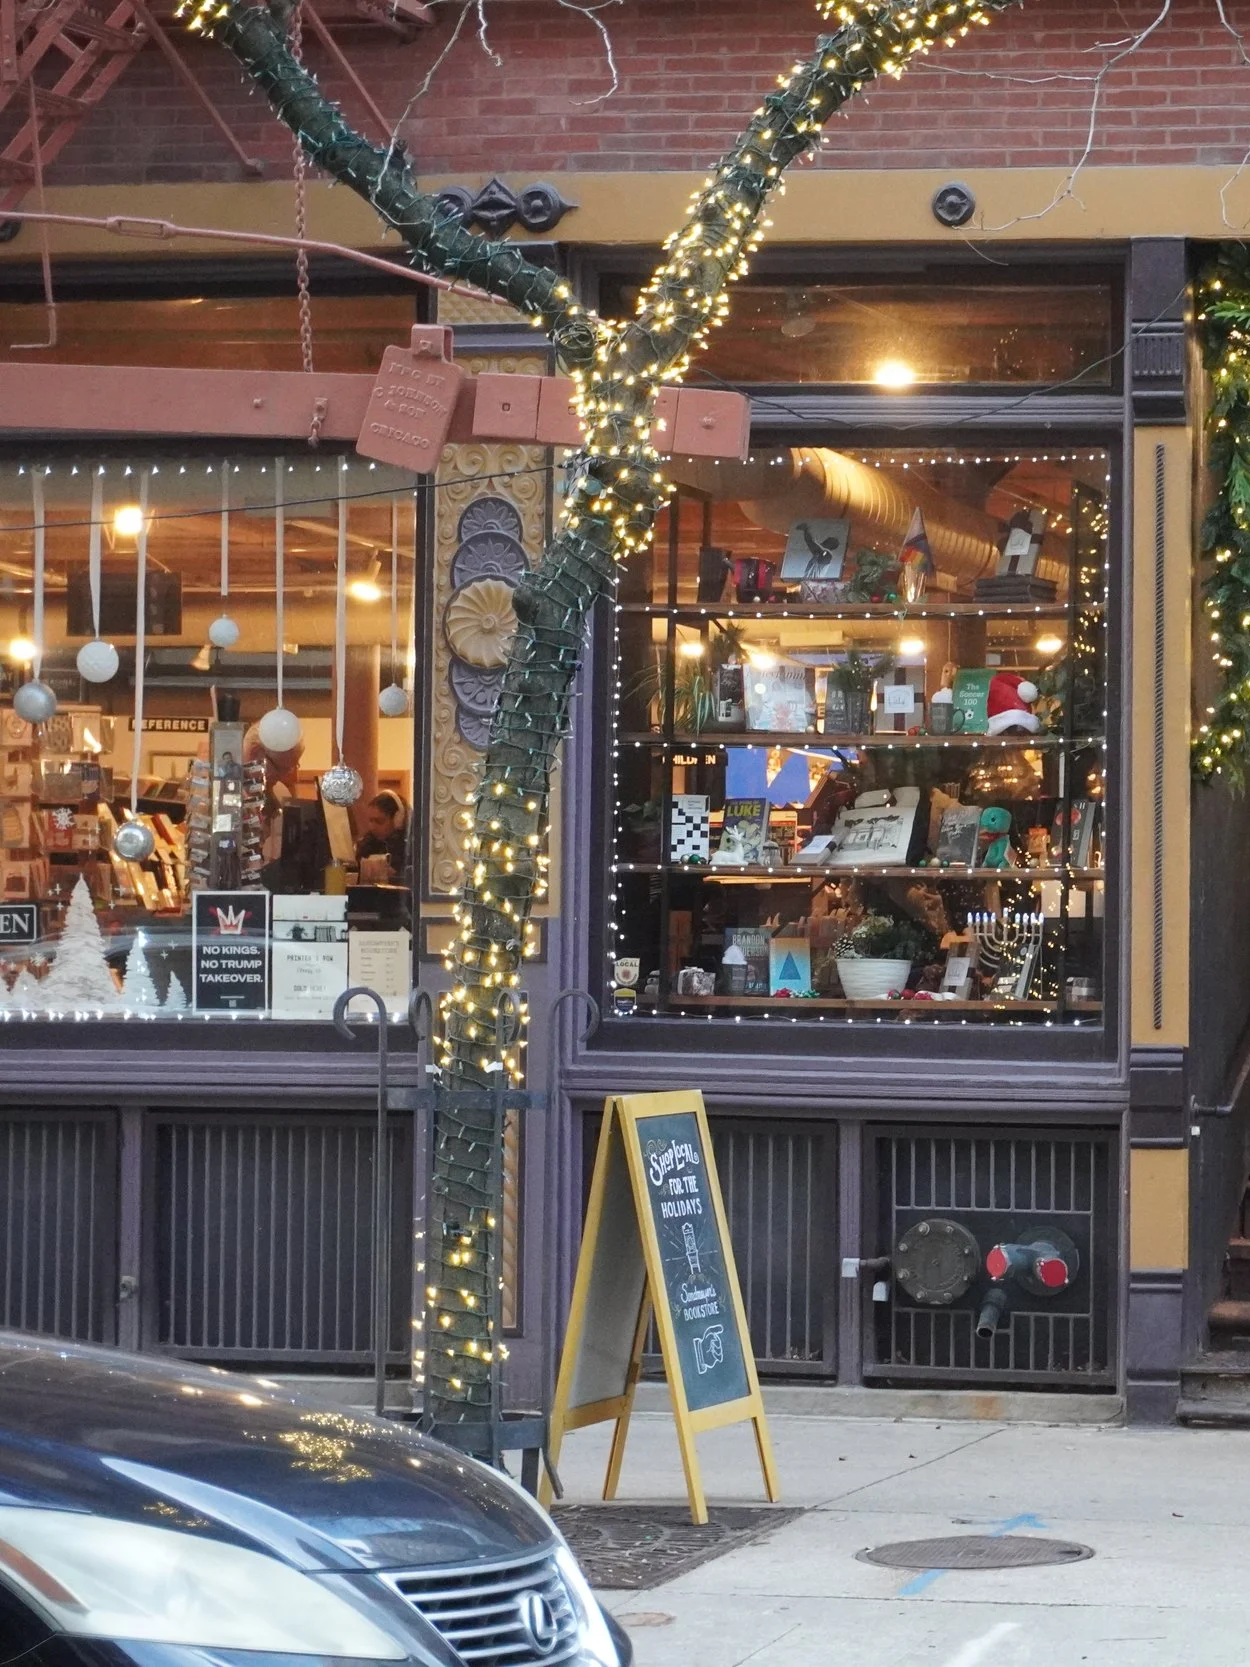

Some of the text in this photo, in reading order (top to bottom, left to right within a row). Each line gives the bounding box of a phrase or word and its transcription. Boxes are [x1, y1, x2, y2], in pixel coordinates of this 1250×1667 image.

[370, 422, 431, 449] CHICAGO
[963, 698, 978, 706] 100
[727, 804, 761, 817] LUKE
[732, 934, 765, 945] BRANDON
[202, 946, 261, 955] NO KINGS.
[200, 959, 262, 969] NO TRUMP
[199, 973, 264, 983] TAKEOVER.
[649, 1139, 700, 1187] SHOP LOCAL
[668, 1175, 699, 1196] FOR THE
[660, 1197, 703, 1219] HOLIDAYS
[683, 1301, 720, 1322] BOOKSTORE
